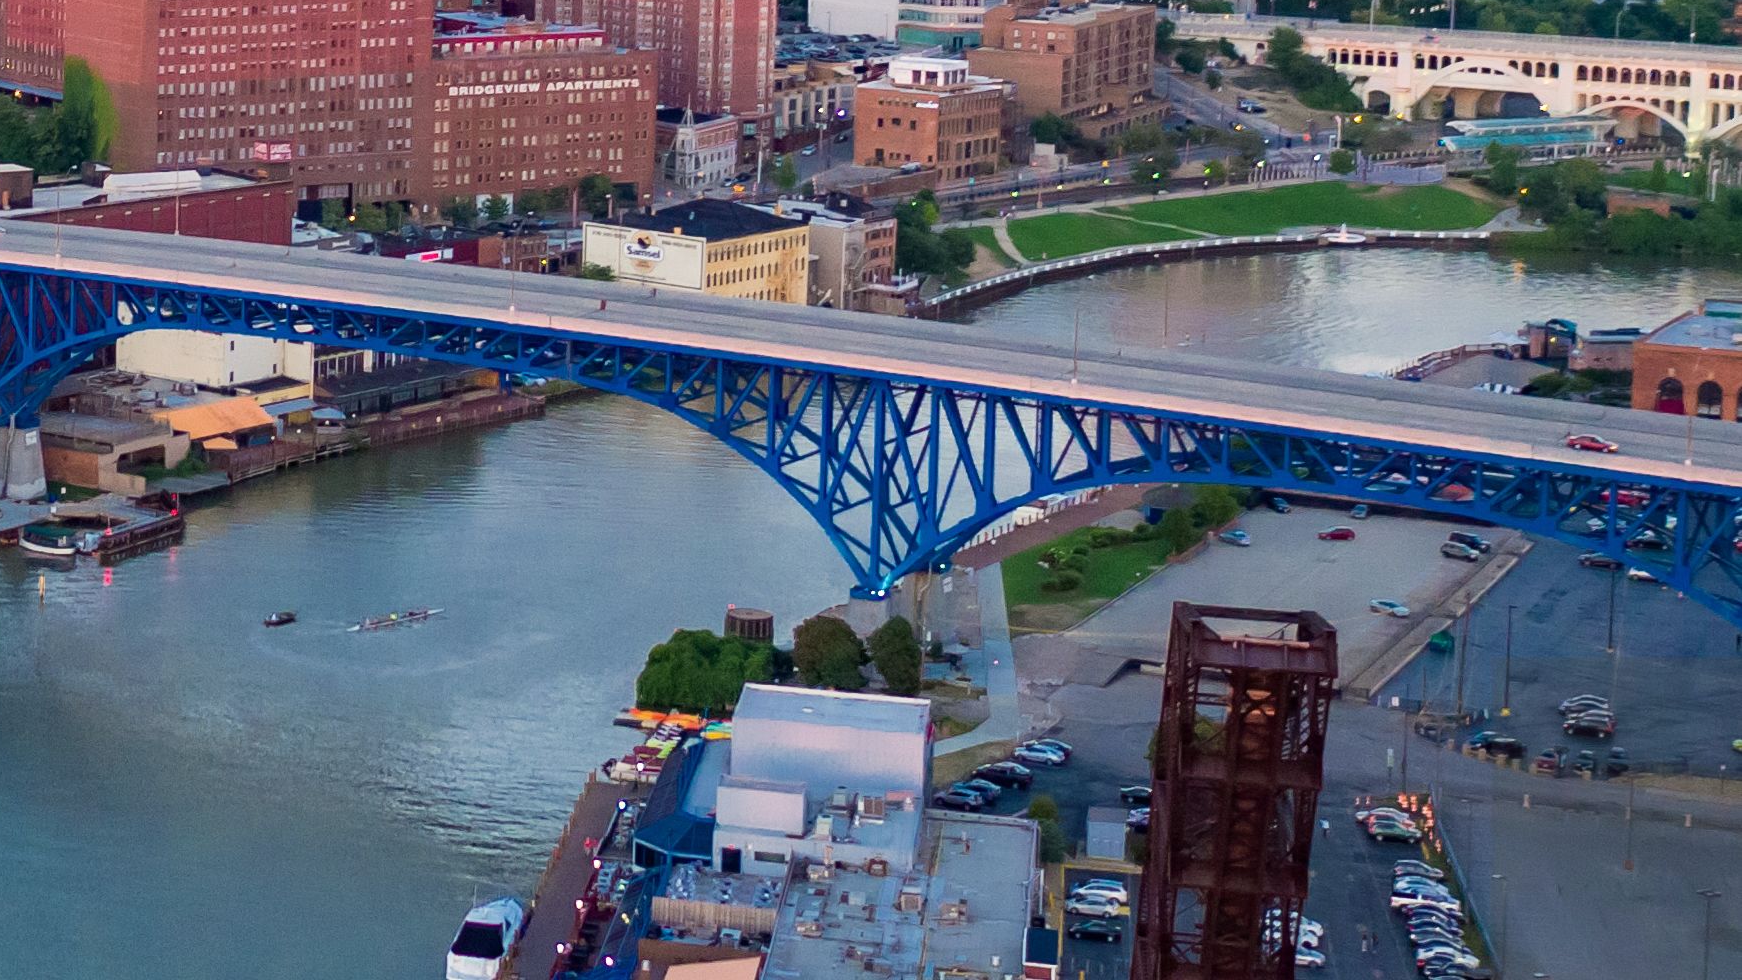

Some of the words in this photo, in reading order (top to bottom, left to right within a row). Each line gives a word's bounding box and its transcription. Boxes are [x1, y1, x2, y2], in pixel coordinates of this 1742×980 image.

[448, 82, 541, 97] BRIDGEVIEW
[545, 78, 640, 92] APARTMENTS
[626, 245, 661, 259] Samsel
